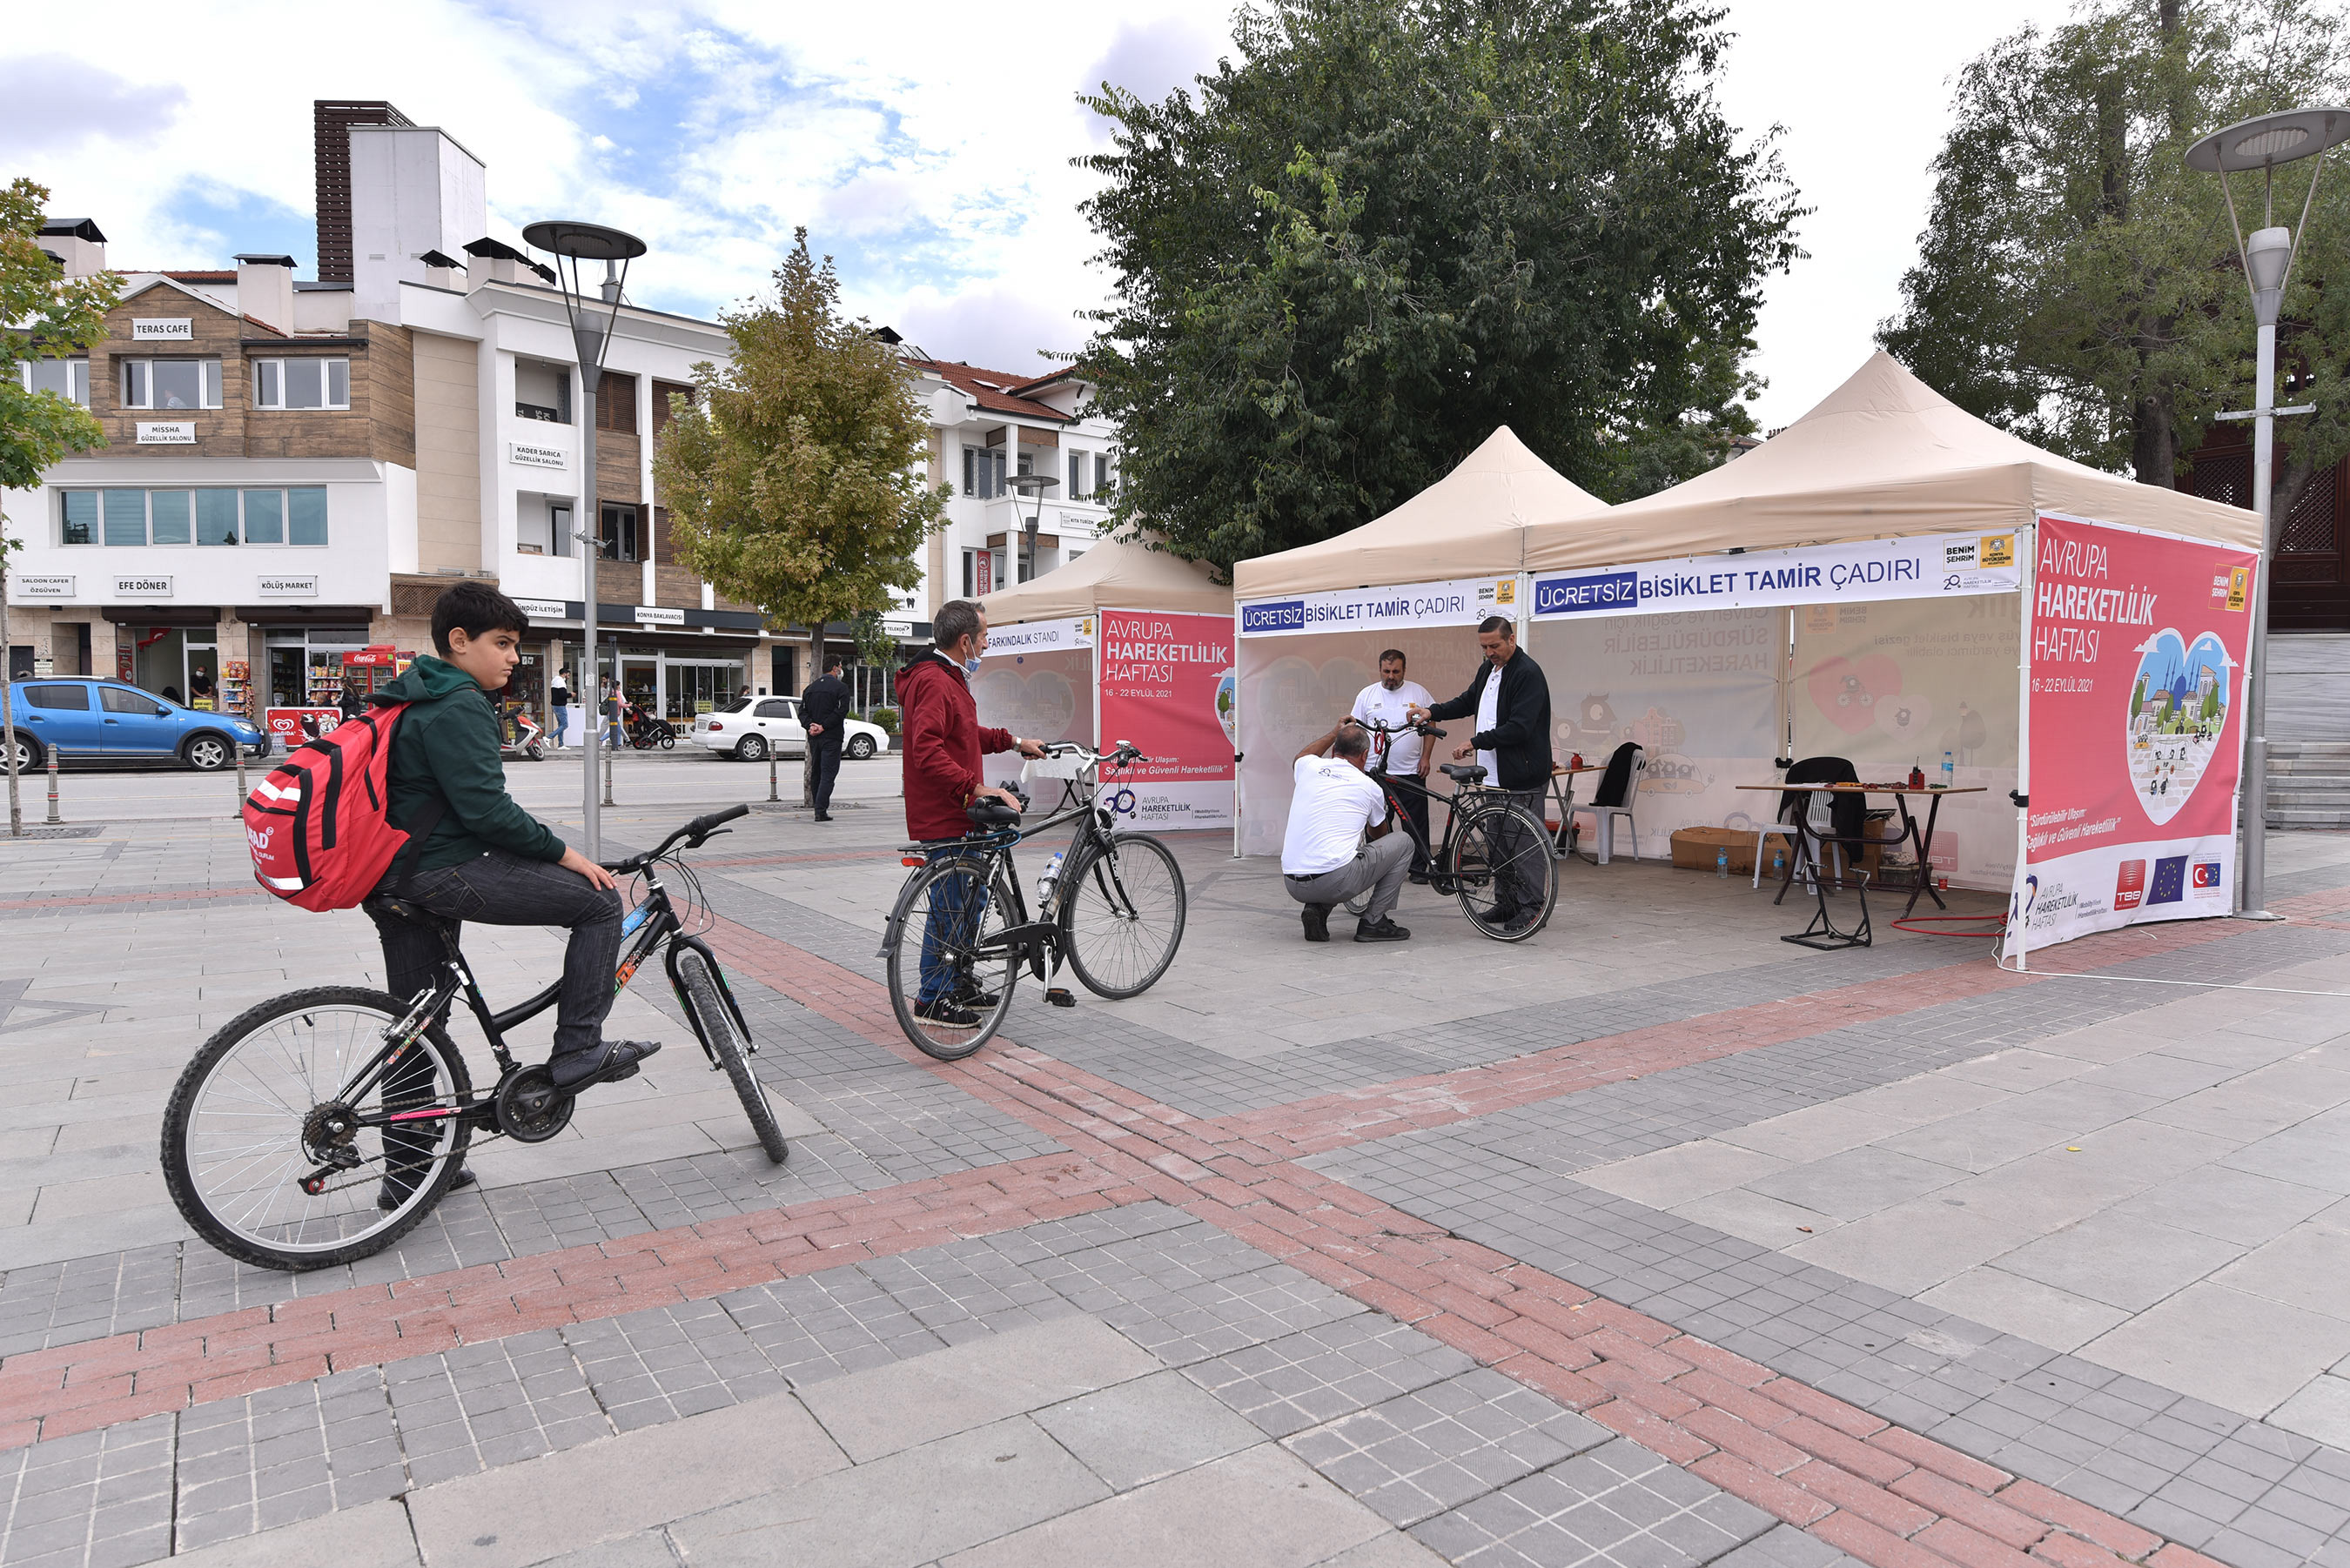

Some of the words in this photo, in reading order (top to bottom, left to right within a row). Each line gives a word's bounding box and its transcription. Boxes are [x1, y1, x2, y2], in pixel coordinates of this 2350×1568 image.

[137, 325, 164, 333] TERAS
[166, 325, 189, 333] CAFE
[514, 454, 541, 463] GÜZELLİK
[517, 446, 538, 455] KADER
[539, 449, 561, 458] SARICA
[1946, 546, 1975, 555] BENİM
[1946, 554, 1975, 564] ŞEHRİM
[2039, 538, 2108, 580] AVRUPA
[137, 579, 167, 590] DÖNER
[261, 580, 284, 591] KÖLÜŞ
[1540, 579, 1633, 607] ÜCRETSİZ
[1640, 573, 1737, 599] BİSİKLET
[1744, 562, 1822, 591] TAMİR
[1830, 558, 1920, 591] ÇADIRI
[517, 603, 538, 612] ÜNDÜZ
[539, 604, 563, 613] İLETİŞİM
[1245, 606, 1303, 627] ÜCRETSİZ
[1306, 602, 1363, 622] BİSİKLET
[1366, 597, 1410, 618] TAMİR
[1414, 595, 1465, 619] ÇADIRI
[2038, 581, 2158, 626] HAREKETLİLİK
[988, 633, 1032, 648] FARKINDALIK
[1033, 630, 1059, 644] STANDI
[1106, 620, 1174, 640] AVRUPA
[1106, 641, 1227, 664] HAREKETLİLİK
[2035, 626, 2100, 663] HAFTASI
[1105, 663, 1173, 683] HAFTASI
[1105, 688, 1114, 697] 16
[1131, 688, 1156, 697] EYLÜL
[2031, 678, 2041, 693] 16
[2045, 678, 2054, 693] 22
[2054, 675, 2077, 693] EYLÜL
[2078, 678, 2094, 692] 2021
[1148, 766, 1179, 774] Güvenli
[1141, 802, 1191, 813] HAREKETLİLİK
[1141, 812, 1169, 821] HAFTASI
[2048, 832, 2057, 844] ve
[2057, 824, 2082, 842] Güvenli
[2039, 882, 2063, 900] AVRUPA
[2117, 890, 2141, 902] TBB
[2035, 891, 2078, 915] HAREKETLİLİK
[2031, 913, 2057, 931] HAFTASI
